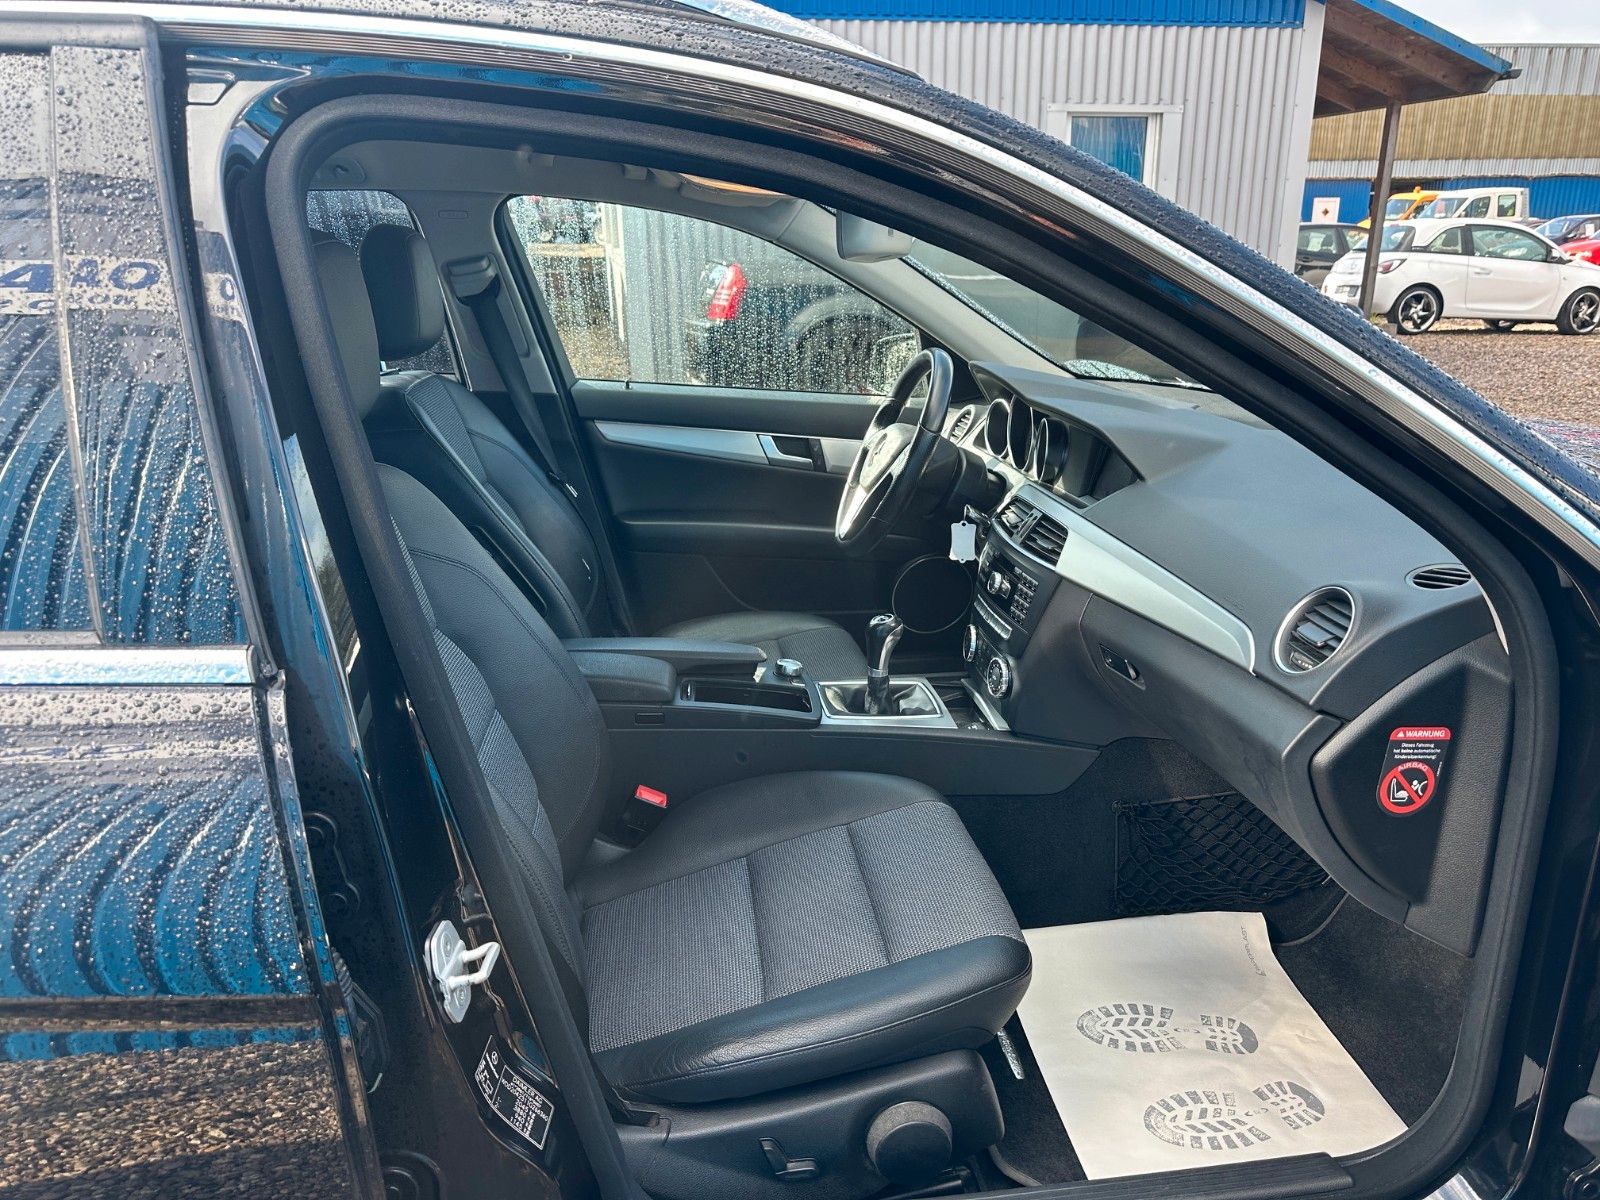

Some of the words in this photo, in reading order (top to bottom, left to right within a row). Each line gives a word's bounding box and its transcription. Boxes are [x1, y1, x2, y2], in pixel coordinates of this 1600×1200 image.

[1397, 761, 1429, 771] AIRBAG
[512, 1076, 535, 1098] DAIMLER
[534, 1095, 543, 1104] AG
